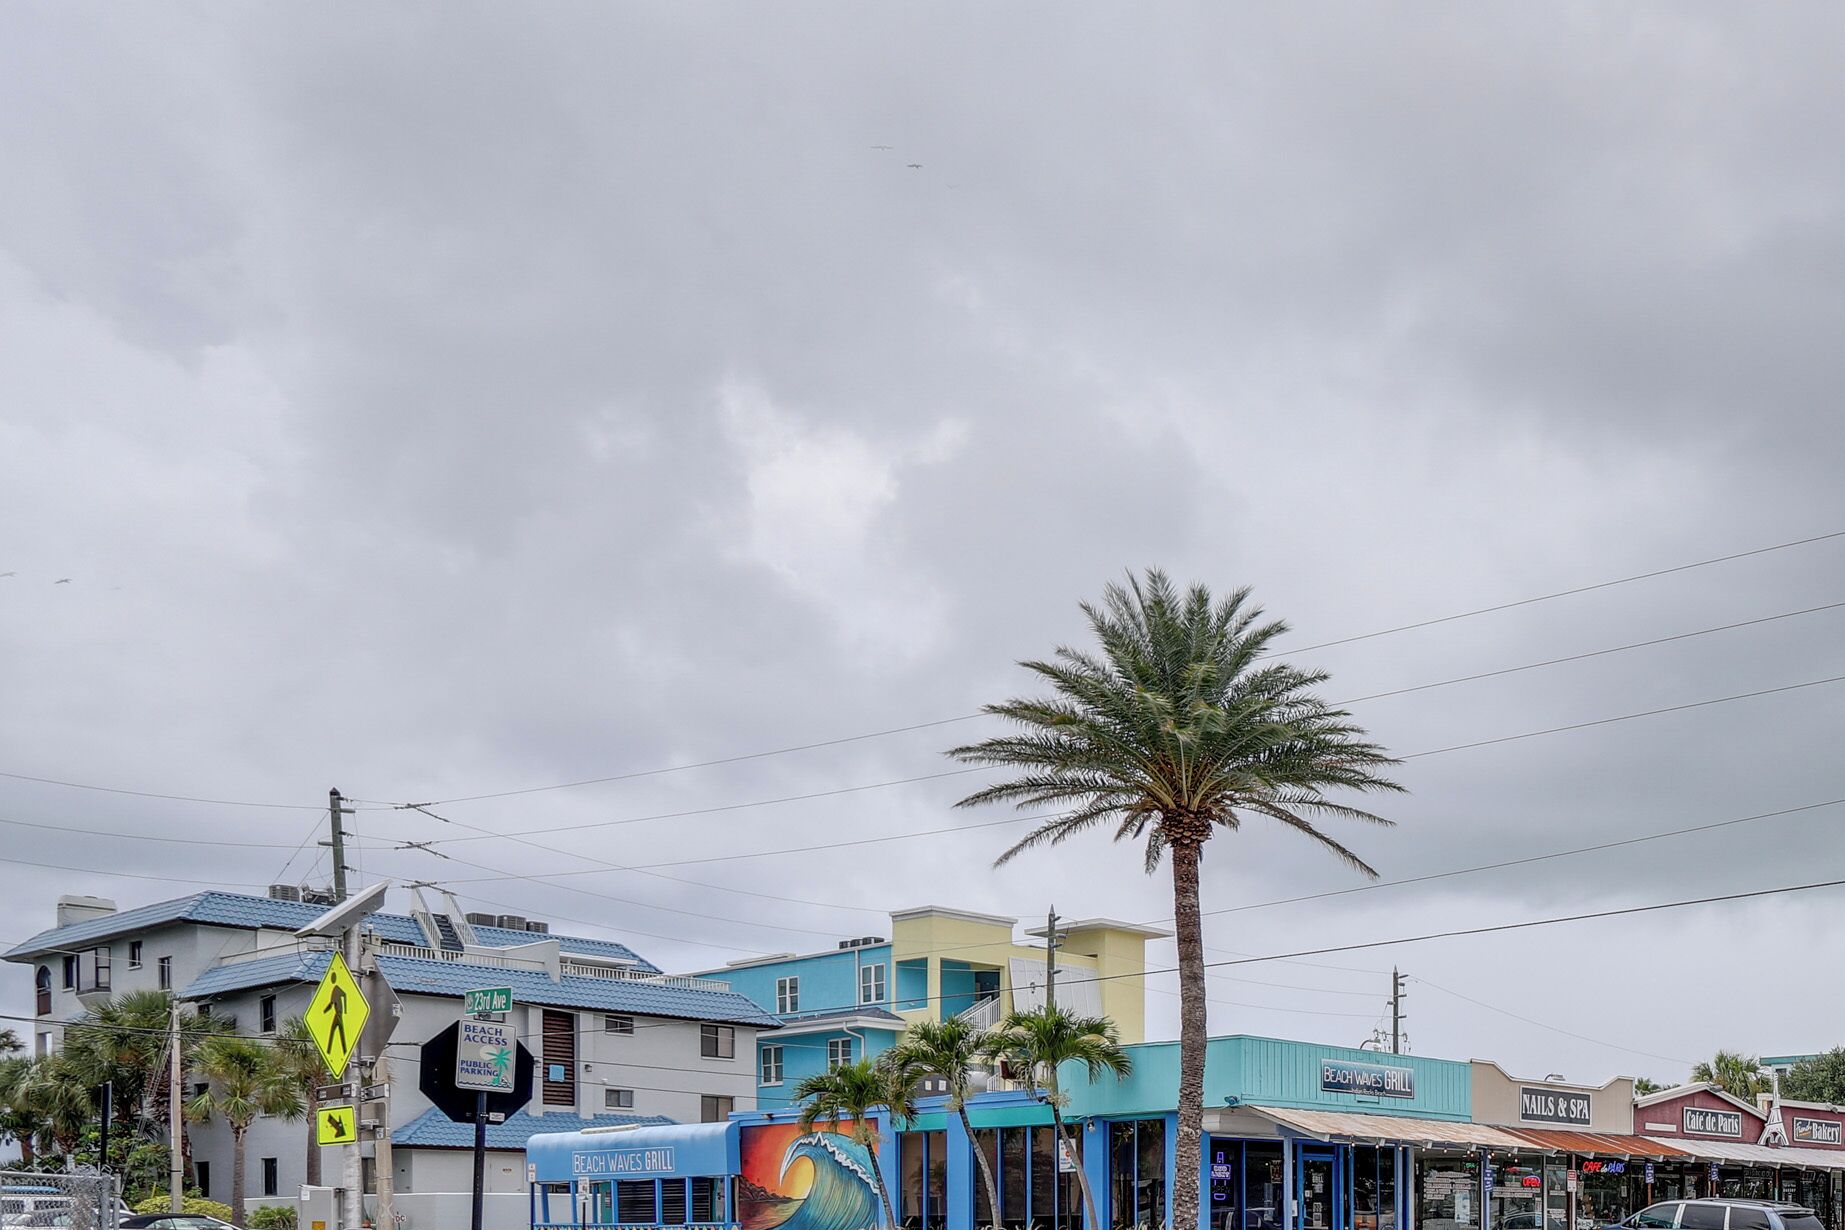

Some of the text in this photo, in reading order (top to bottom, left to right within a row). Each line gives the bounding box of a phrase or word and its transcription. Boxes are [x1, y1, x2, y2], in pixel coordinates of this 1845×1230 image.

[474, 991, 507, 1010] 23rd Ave
[464, 1024, 503, 1036] BEACH
[464, 1034, 508, 1046] ACCESS
[460, 1060, 492, 1069] PUBLIC
[460, 1067, 499, 1077] PARKING
[1324, 1066, 1412, 1092] BEACH WAVES GRILL
[1522, 1093, 1590, 1120] NAILS & SPA
[1686, 1110, 1739, 1134] Café de Paris
[1812, 1122, 1840, 1144] Bakery
[574, 1150, 673, 1173] BEACH WAVES GRILL
[1583, 1161, 1602, 1173] CAFE
[1522, 1176, 1540, 1187] OPEN
